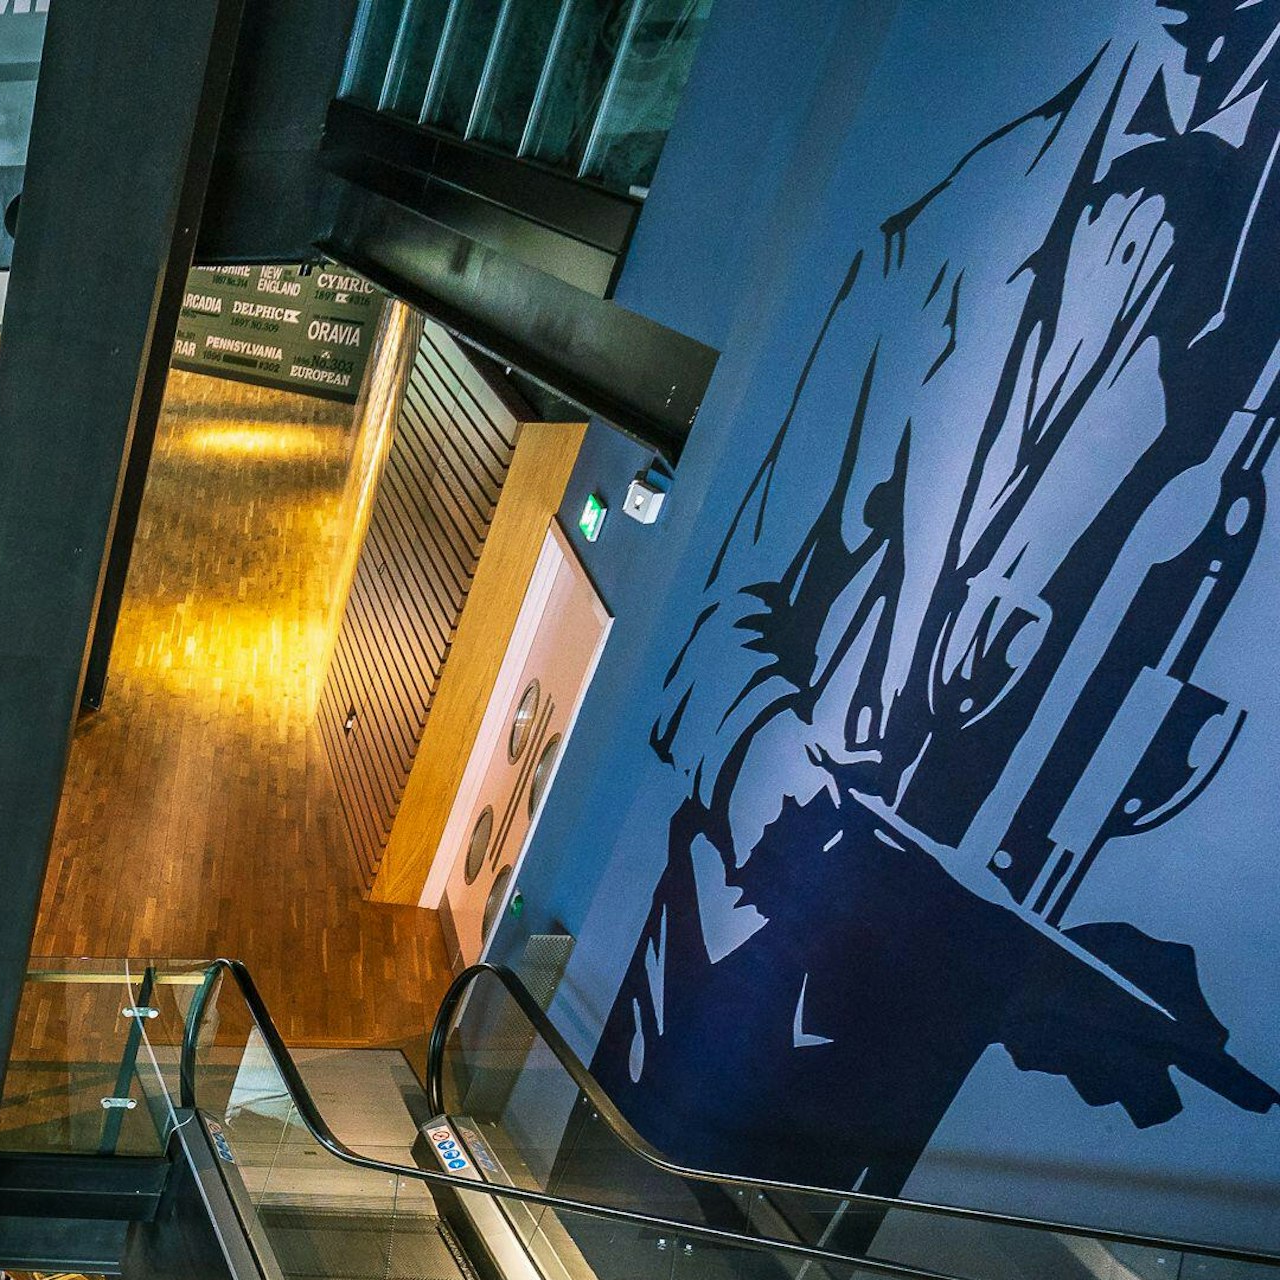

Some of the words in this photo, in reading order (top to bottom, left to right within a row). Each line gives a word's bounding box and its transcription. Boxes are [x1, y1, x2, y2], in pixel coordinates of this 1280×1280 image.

[260, 265, 283, 281] NEW
[257, 278, 301, 297] ENGLAND
[317, 273, 375, 294] CYMRIC
[232, 301, 285, 321] DELPHIC
[307, 320, 362, 347] ORAVIA
[205, 335, 283, 361] PENNSYLVANIA
[311, 355, 355, 373] No.303
[289, 365, 351, 387] EUROPEAN
